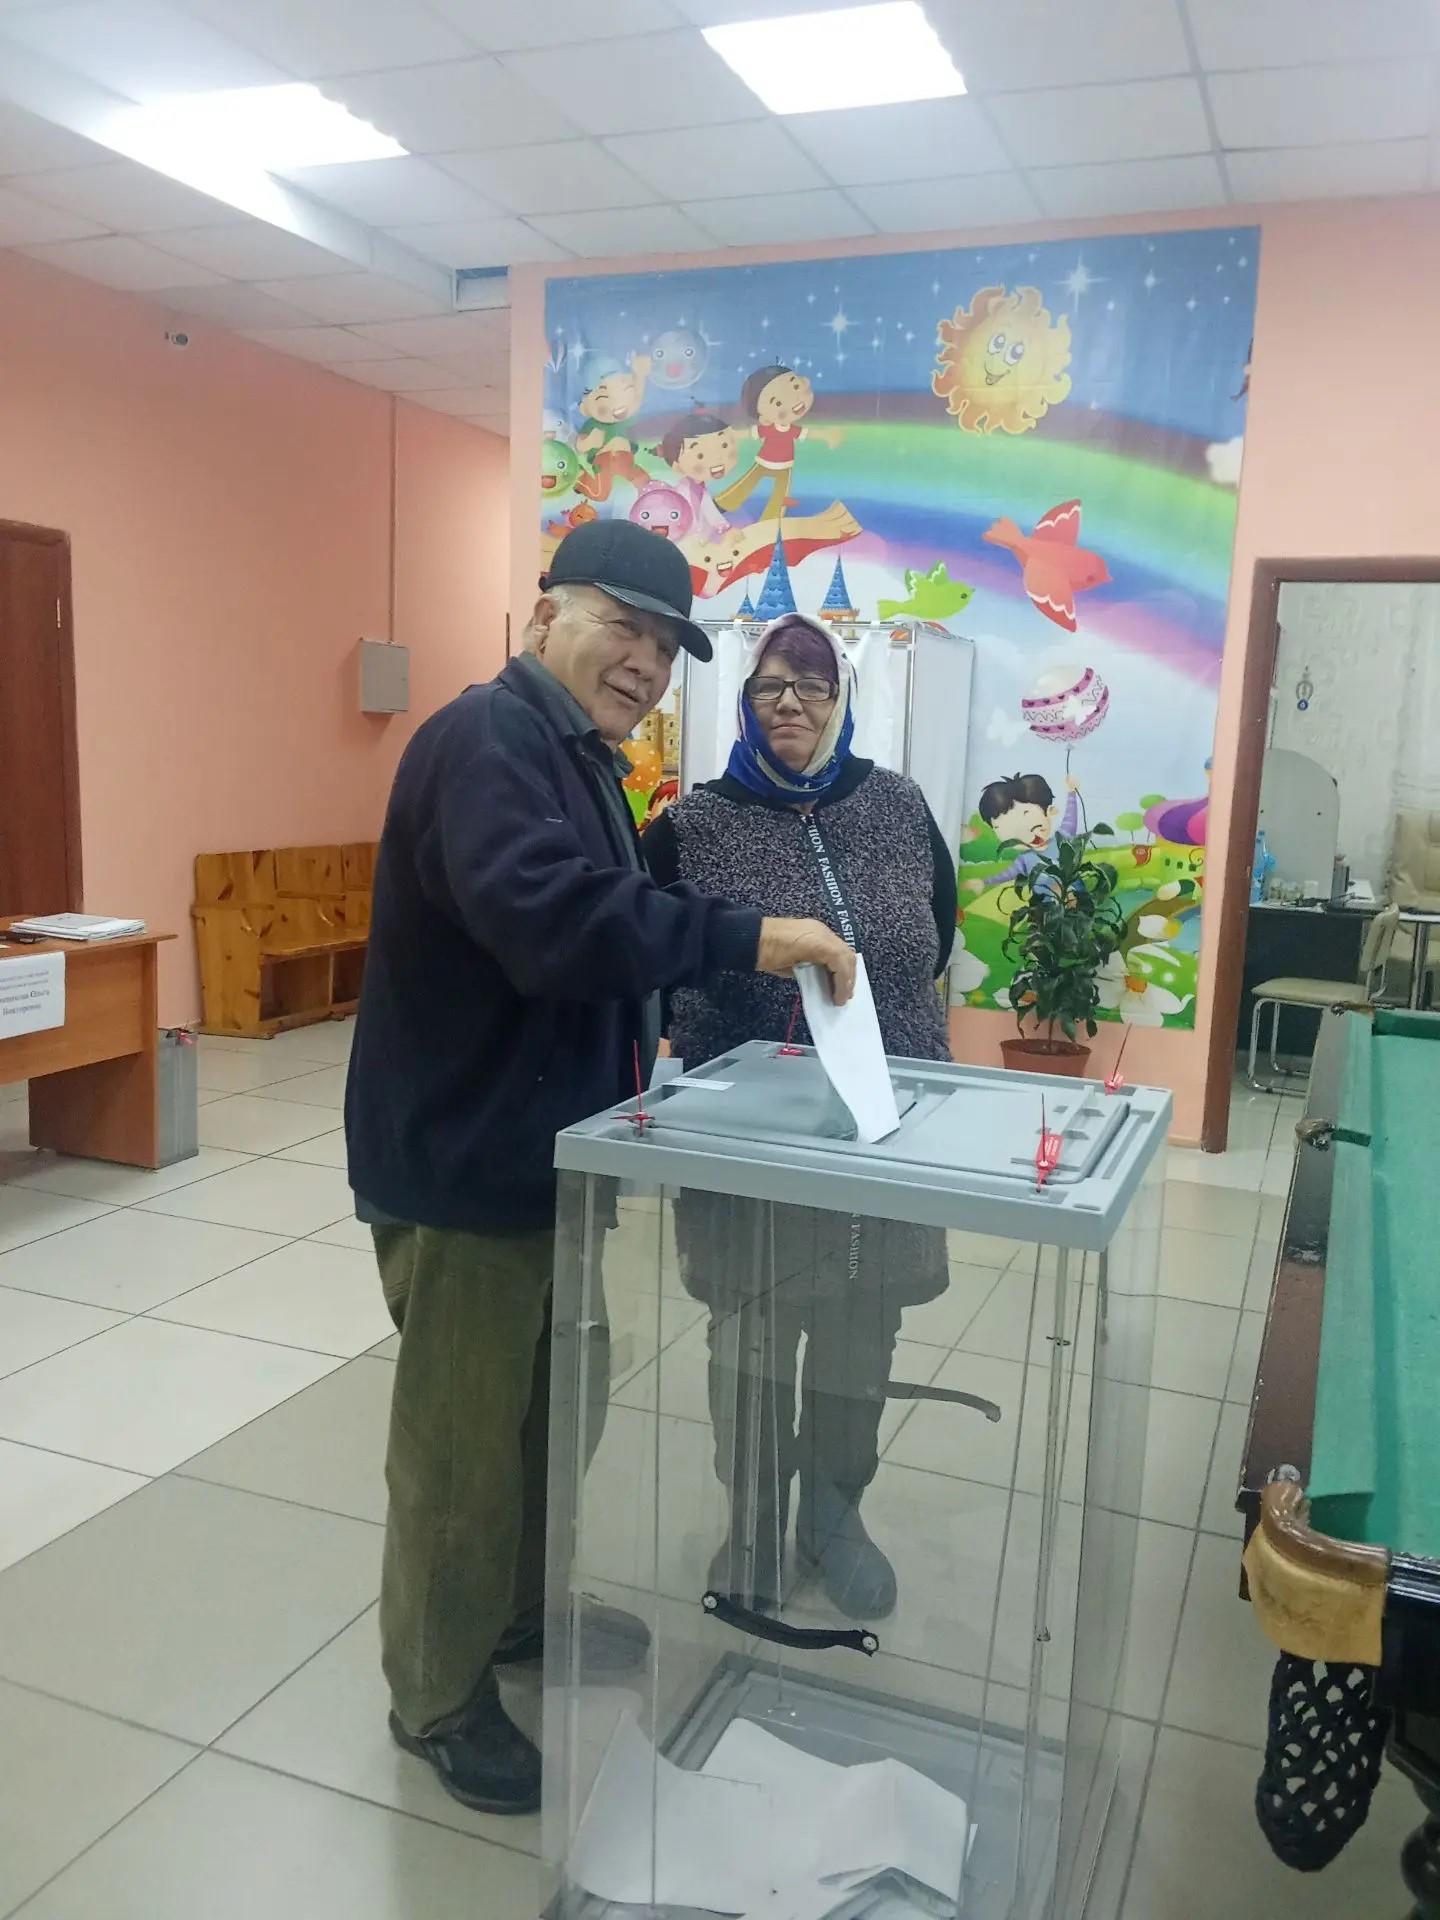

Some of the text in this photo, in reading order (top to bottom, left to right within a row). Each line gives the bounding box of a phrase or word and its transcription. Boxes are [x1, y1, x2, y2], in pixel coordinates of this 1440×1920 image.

[818, 857, 844, 905] FASHION
[837, 910, 856, 947] FASHI
[849, 1224, 860, 1279] FASHION
